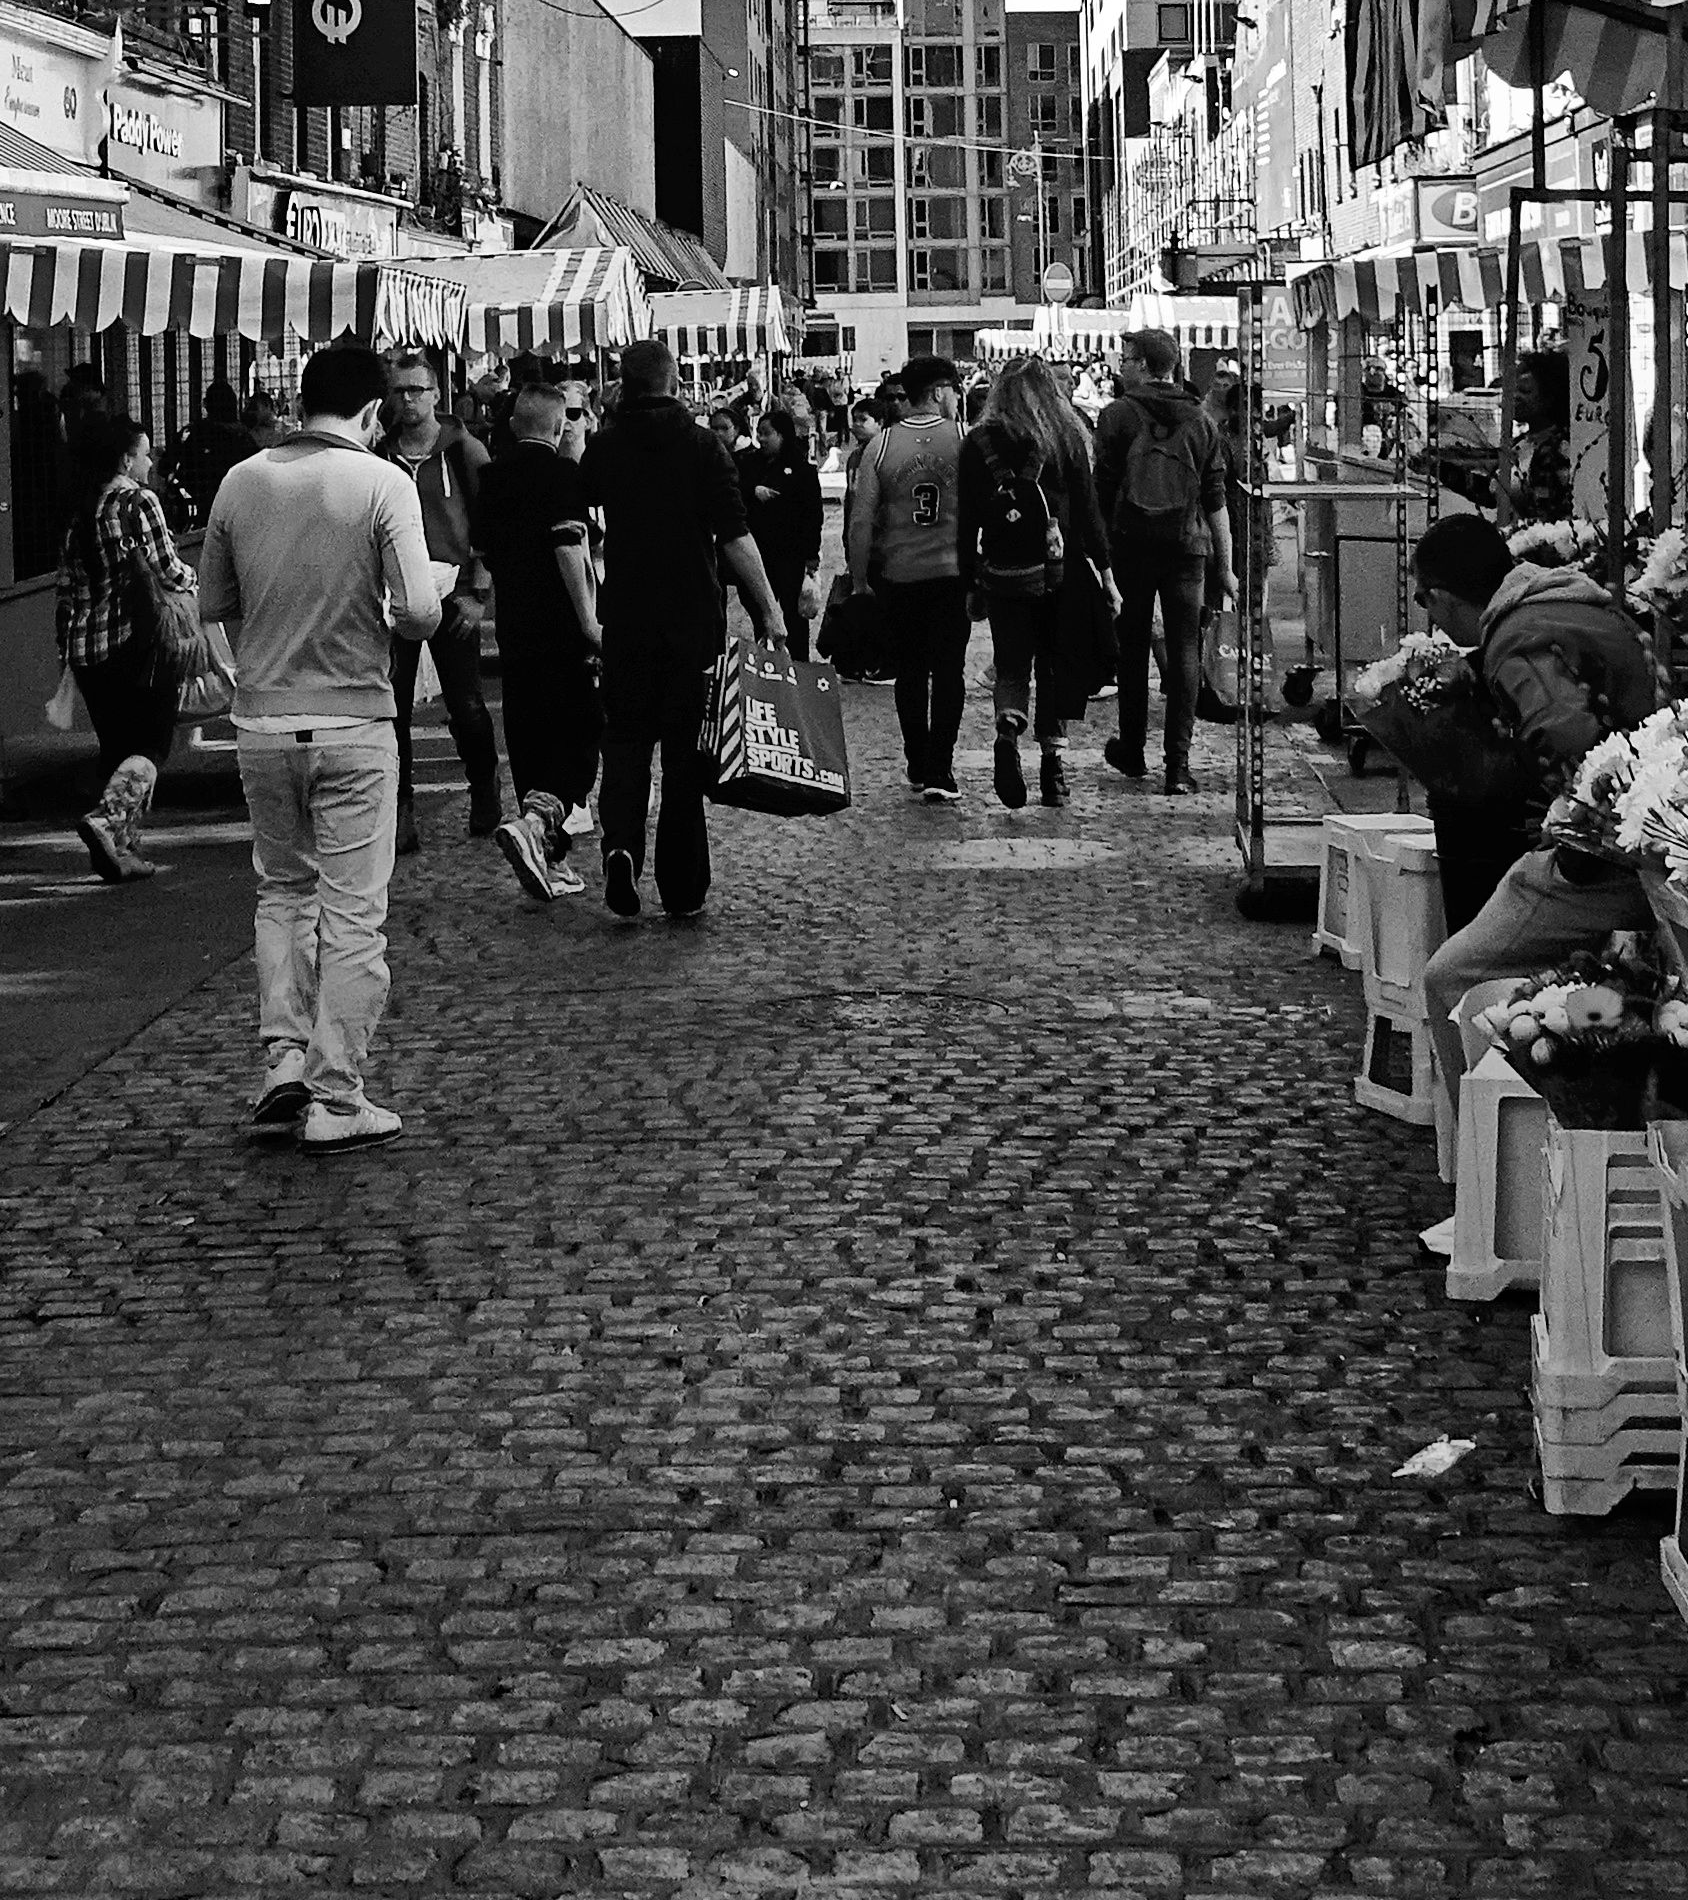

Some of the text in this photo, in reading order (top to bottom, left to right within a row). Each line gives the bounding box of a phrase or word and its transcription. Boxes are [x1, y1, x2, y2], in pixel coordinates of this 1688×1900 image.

[111, 102, 184, 158] Paddy Power
[1579, 328, 1610, 403] 5
[912, 482, 940, 526] 3
[745, 695, 777, 722] LIFE
[744, 722, 800, 749] STYLE
